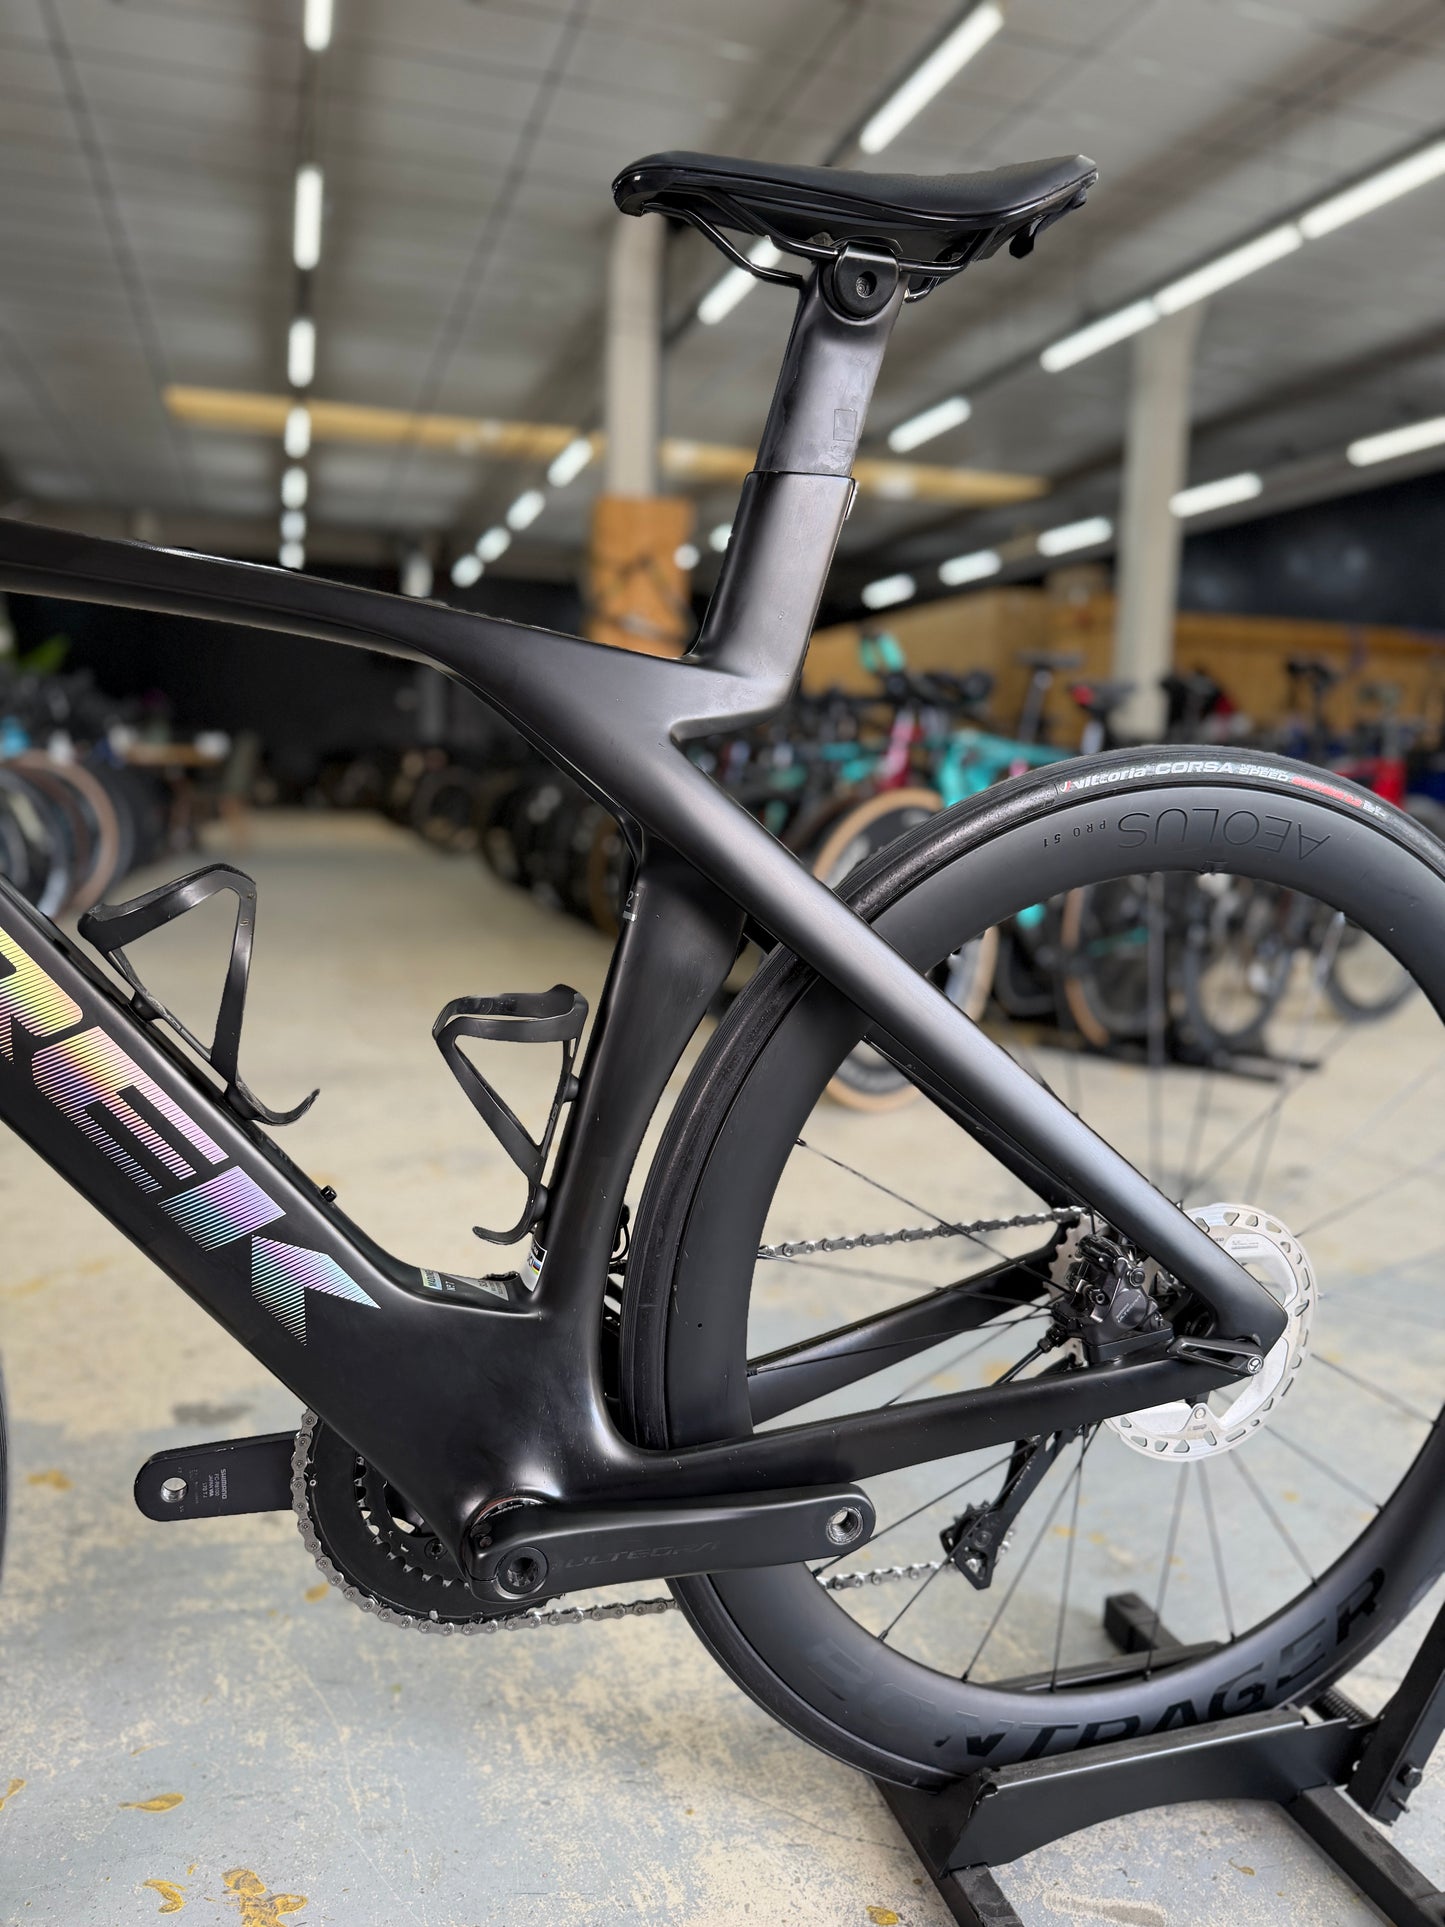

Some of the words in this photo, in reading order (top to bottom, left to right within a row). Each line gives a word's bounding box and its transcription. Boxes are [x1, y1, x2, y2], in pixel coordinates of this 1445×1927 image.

[1155, 761, 1233, 775] CORSA
[1073, 820, 1106, 837] PRO
[1118, 808, 1331, 859] AEOLUS
[1044, 833, 1061, 848] 51
